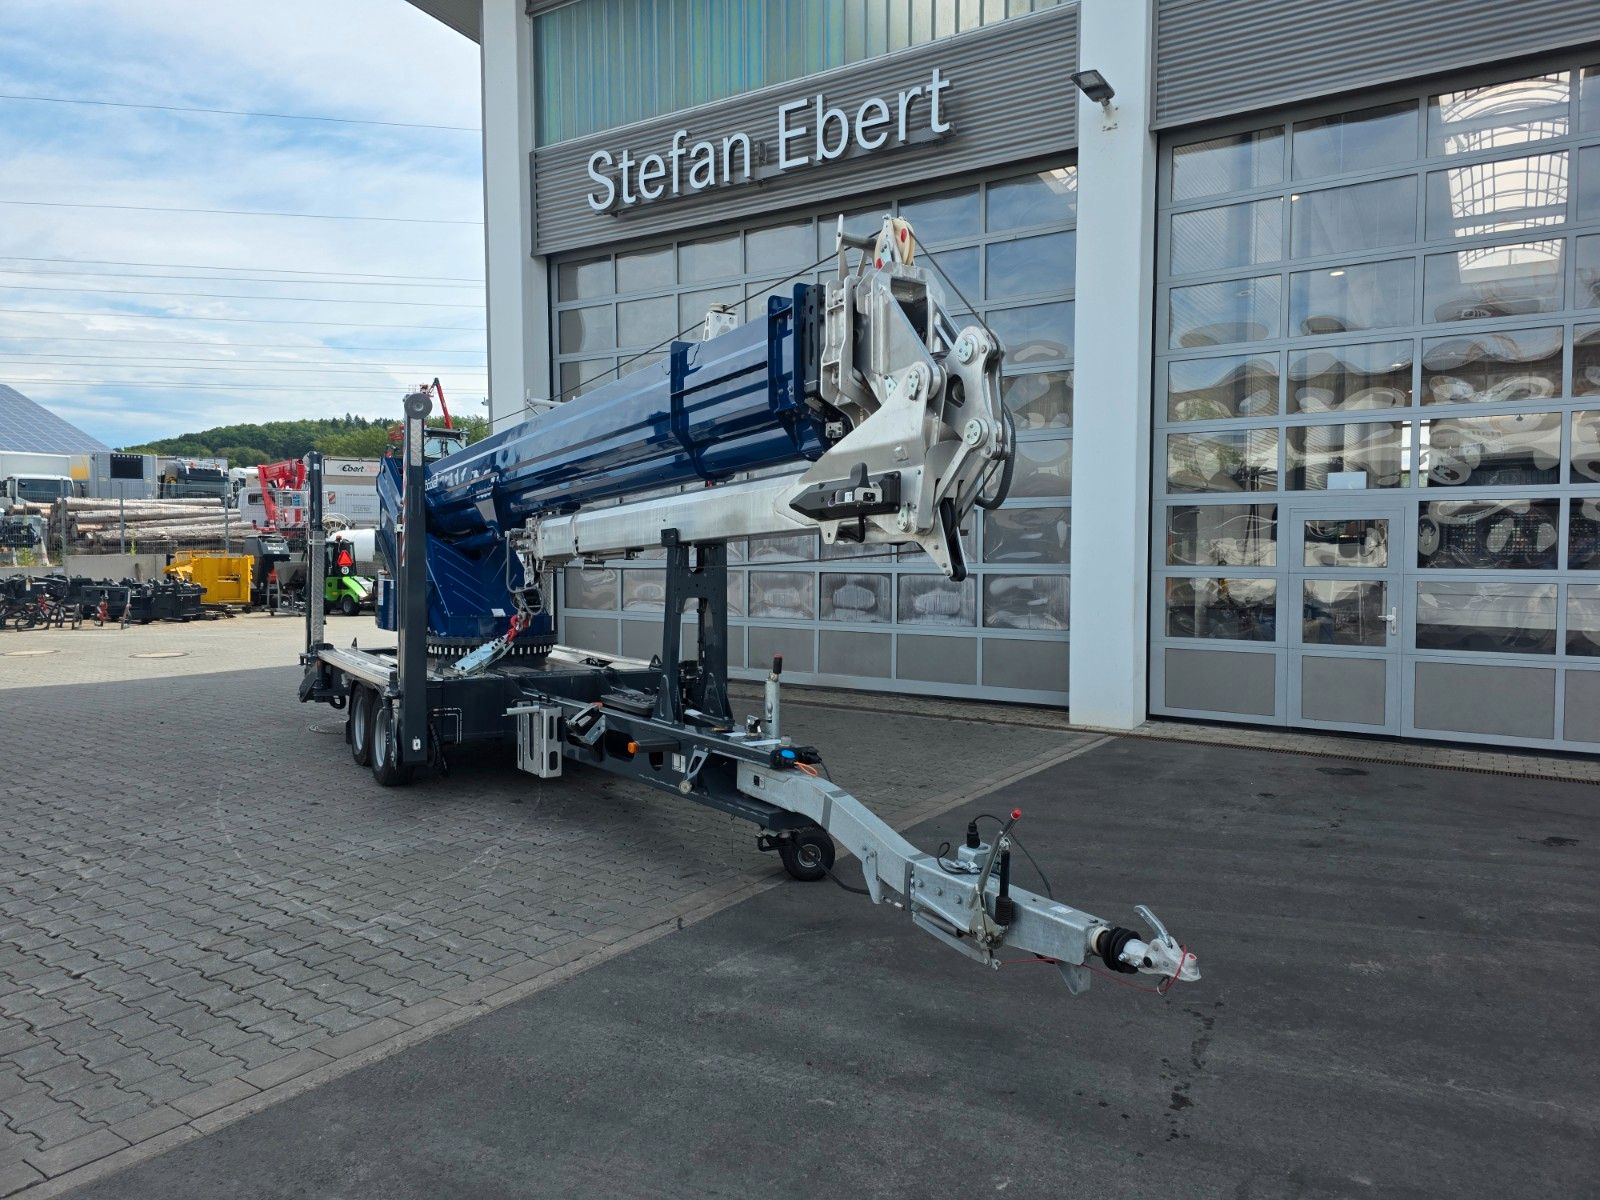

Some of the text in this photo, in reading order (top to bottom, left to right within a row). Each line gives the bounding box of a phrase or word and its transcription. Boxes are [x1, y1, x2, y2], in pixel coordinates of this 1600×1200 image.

[587, 68, 951, 211] Stefan Ebert
[342, 464, 364, 472] Ebert
